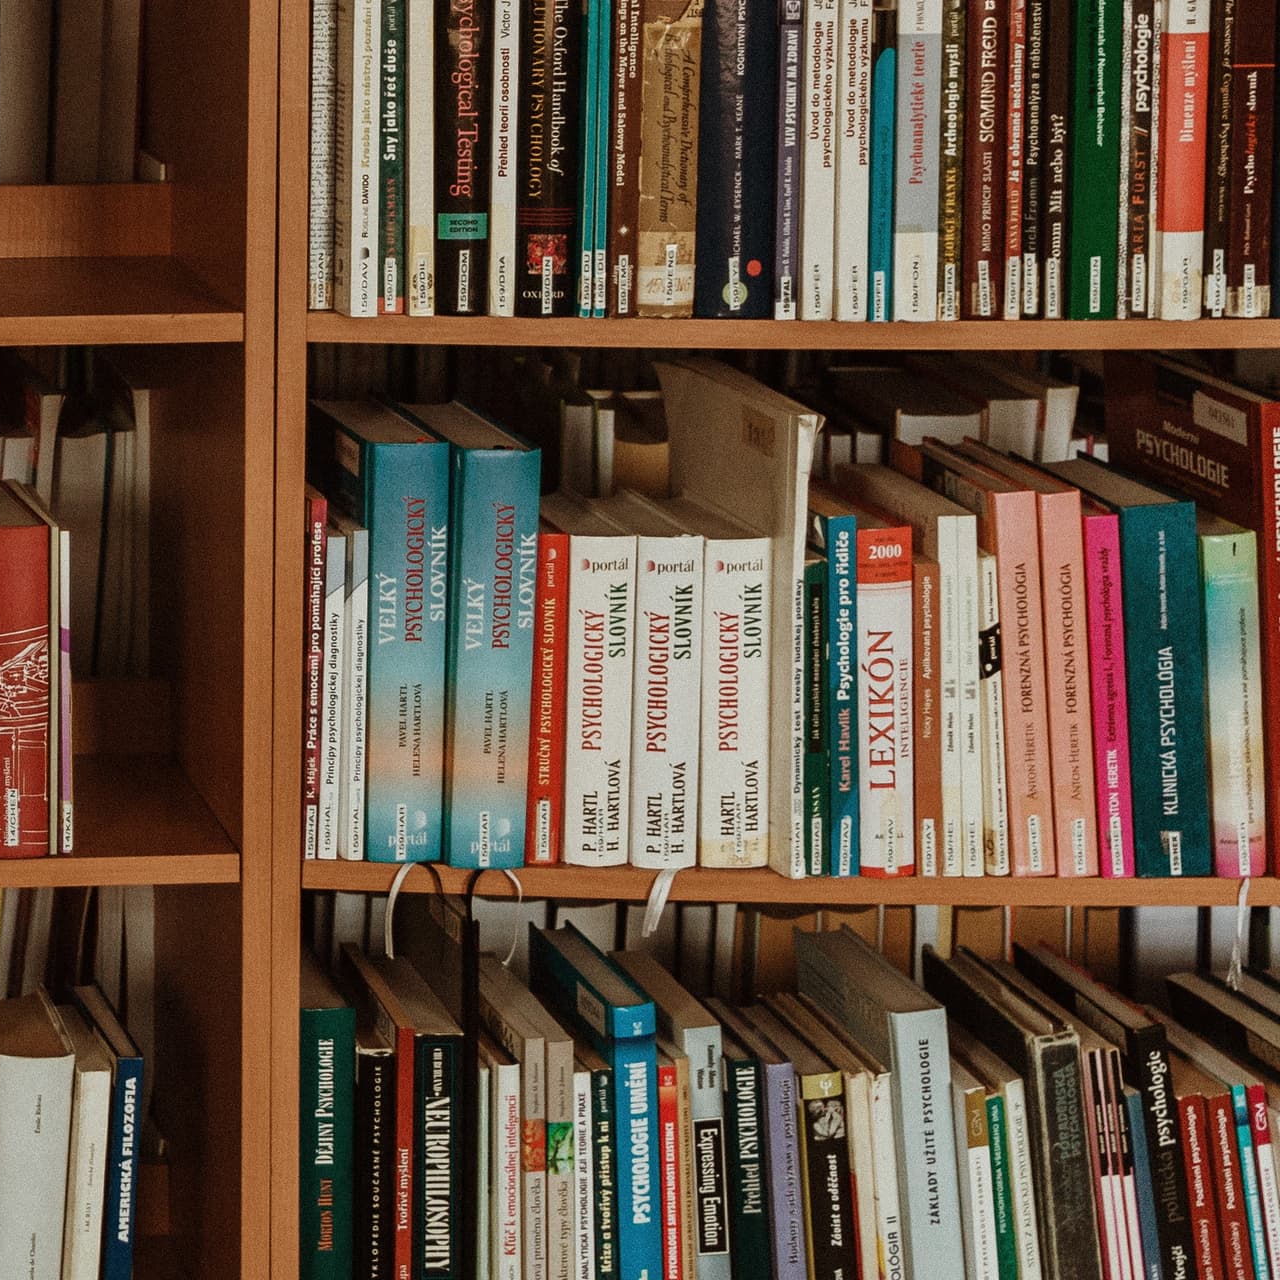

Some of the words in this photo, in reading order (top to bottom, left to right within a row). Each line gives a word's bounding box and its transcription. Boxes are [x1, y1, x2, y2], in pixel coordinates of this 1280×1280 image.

[383, 39, 396, 69] duše
[383, 73, 396, 96] řeč
[383, 100, 398, 132] jako
[383, 132, 399, 162] Sny
[449, 123, 481, 199] Testing
[592, 559, 629, 571] portál
[836, 532, 849, 574] řidiče
[869, 545, 902, 559] 2000
[839, 579, 852, 605] pro
[579, 607, 605, 753] PSYCHOLOGICKÝ
[837, 609, 853, 701] Psychologie
[862, 630, 896, 791] LEXIKÓN
[899, 657, 909, 759] INTELIGENCIE
[316, 1039, 335, 1118] PSYCHOLOGIE
[920, 1038, 933, 1125] PSYCHOLOGIE
[123, 1077, 137, 1161] FILOZOFIA
